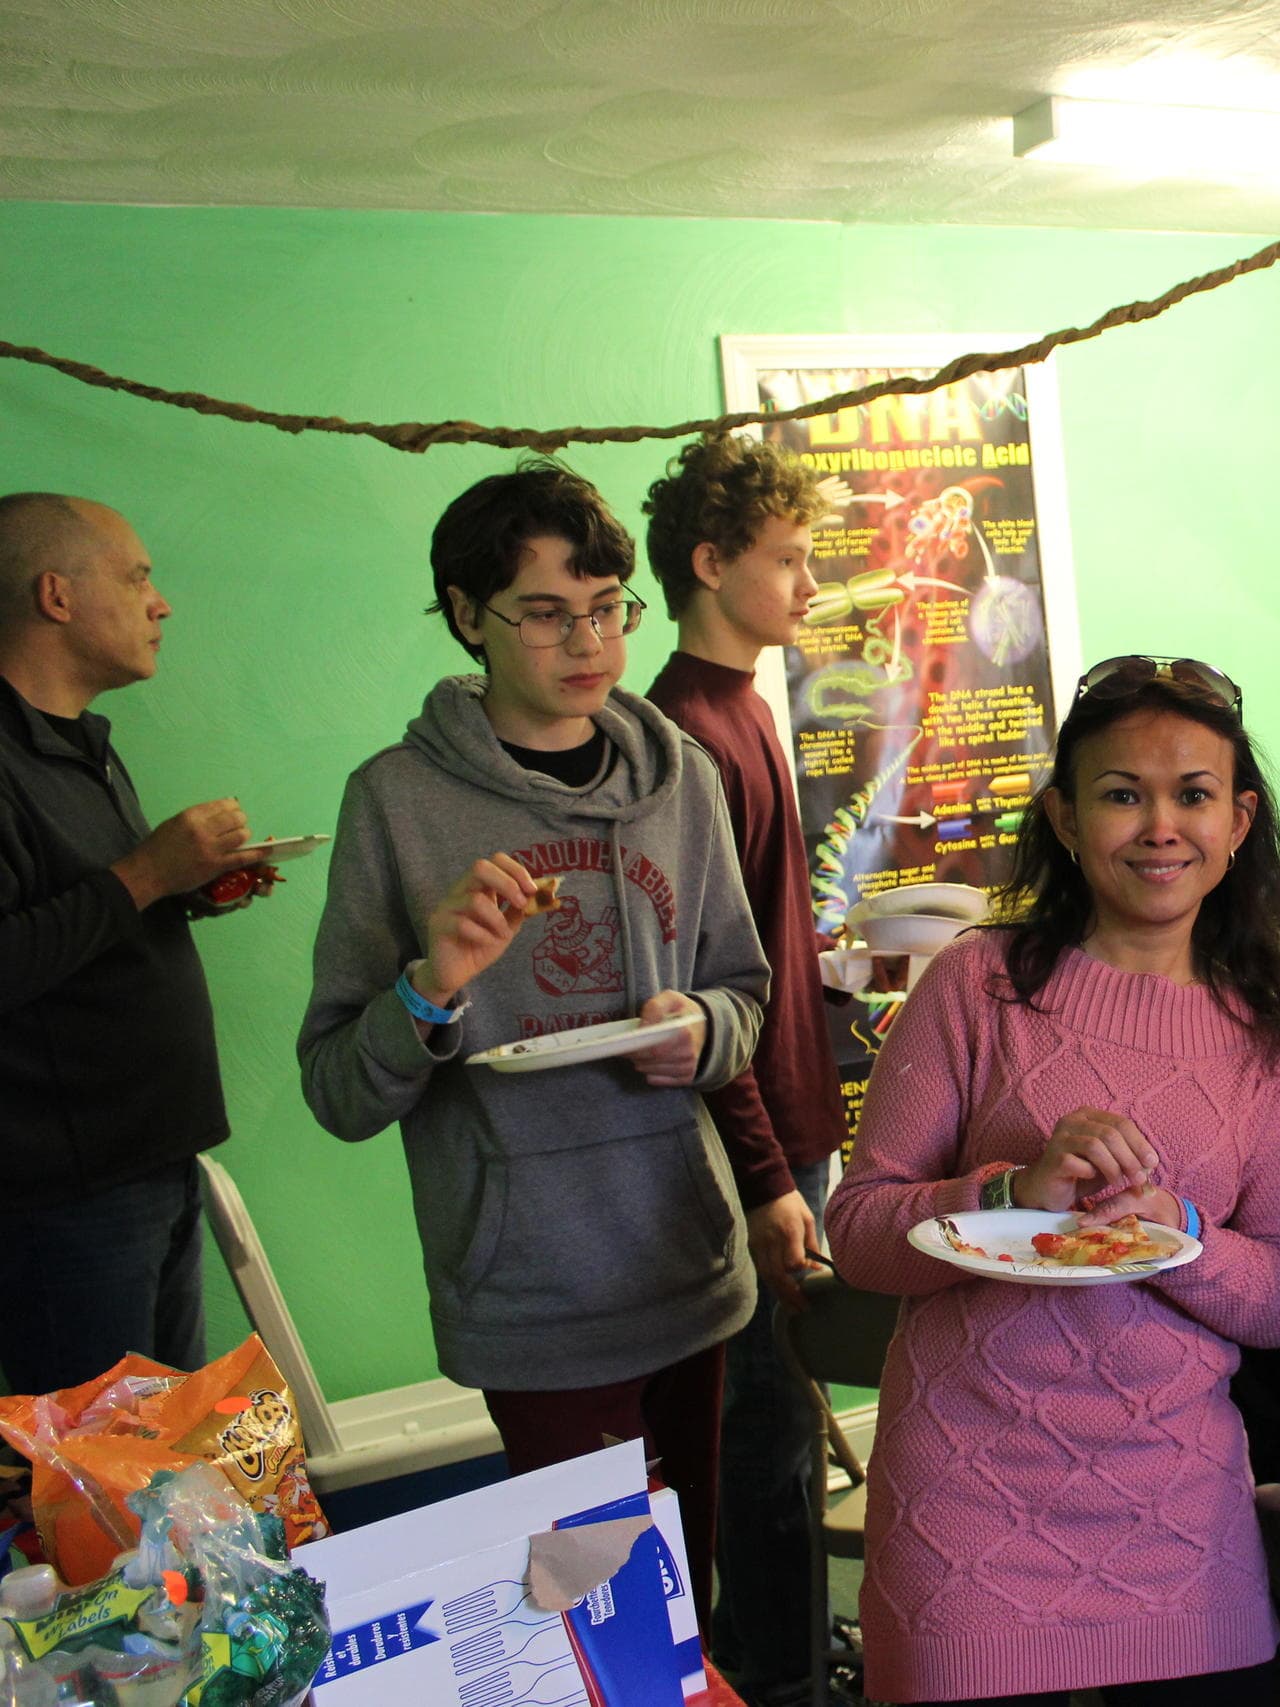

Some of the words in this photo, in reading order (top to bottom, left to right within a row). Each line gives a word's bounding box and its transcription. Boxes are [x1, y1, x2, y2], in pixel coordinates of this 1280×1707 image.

[800, 371, 984, 446] DNA
[787, 444, 977, 472] oxyribonucleic
[982, 442, 1031, 469] Acid
[982, 520, 996, 528] The
[1016, 518, 1035, 528] blood
[823, 528, 846, 539] blood
[812, 540, 832, 549] many
[834, 537, 873, 547] different
[814, 549, 837, 559] types
[838, 547, 848, 556] of
[915, 601, 932, 610] The
[960, 598, 968, 607] of
[918, 612, 924, 620] a
[834, 634, 842, 642] of
[845, 632, 864, 642] DNA
[928, 692, 946, 702] The
[951, 689, 972, 700] DNA
[975, 687, 1005, 698] strand
[1007, 685, 1024, 696] has
[1026, 686, 1034, 694] a
[922, 716, 944, 726] with
[947, 714, 962, 724] two
[966, 710, 994, 722] halves
[997, 704, 1044, 718] connected
[928, 702, 958, 714] double
[961, 700, 984, 712] helix
[925, 728, 934, 738] in
[938, 726, 953, 736] the
[956, 722, 986, 734] middle
[988, 720, 1007, 731] and
[1009, 716, 1044, 728] twisted
[800, 732, 815, 742] The
[817, 730, 836, 740] DNA
[800, 738, 846, 750] chromosome
[939, 736, 956, 748] like
[958, 737, 966, 746] a
[968, 732, 994, 746] spiral
[804, 750, 828, 760] wound
[830, 748, 844, 758] like
[832, 754, 856, 766] coiled
[907, 766, 921, 775] The
[942, 762, 956, 772] part
[957, 760, 966, 769] of
[966, 759, 982, 768] DNA
[983, 758, 990, 766] is
[991, 756, 1008, 764] made
[1009, 754, 1017, 762] of
[948, 771, 964, 781] pairs
[966, 768, 982, 778] with
[933, 802, 972, 816] Adenine
[934, 839, 978, 856] Cytosine
[853, 870, 898, 882] Alternating
[900, 866, 920, 880] sugar
[921, 863, 936, 874] and
[857, 879, 897, 892] phosphate
[900, 873, 934, 886] molecules
[622, 848, 678, 946] ABBE
[588, 1588, 603, 1623] Fourchette
[600, 1584, 614, 1617] Tenedores
[396, 1612, 412, 1651] resistentes
[370, 1622, 387, 1661] Duraderos
[336, 1650, 346, 1660] et
[345, 1633, 362, 1667] durables
[323, 1648, 337, 1679] Reista
